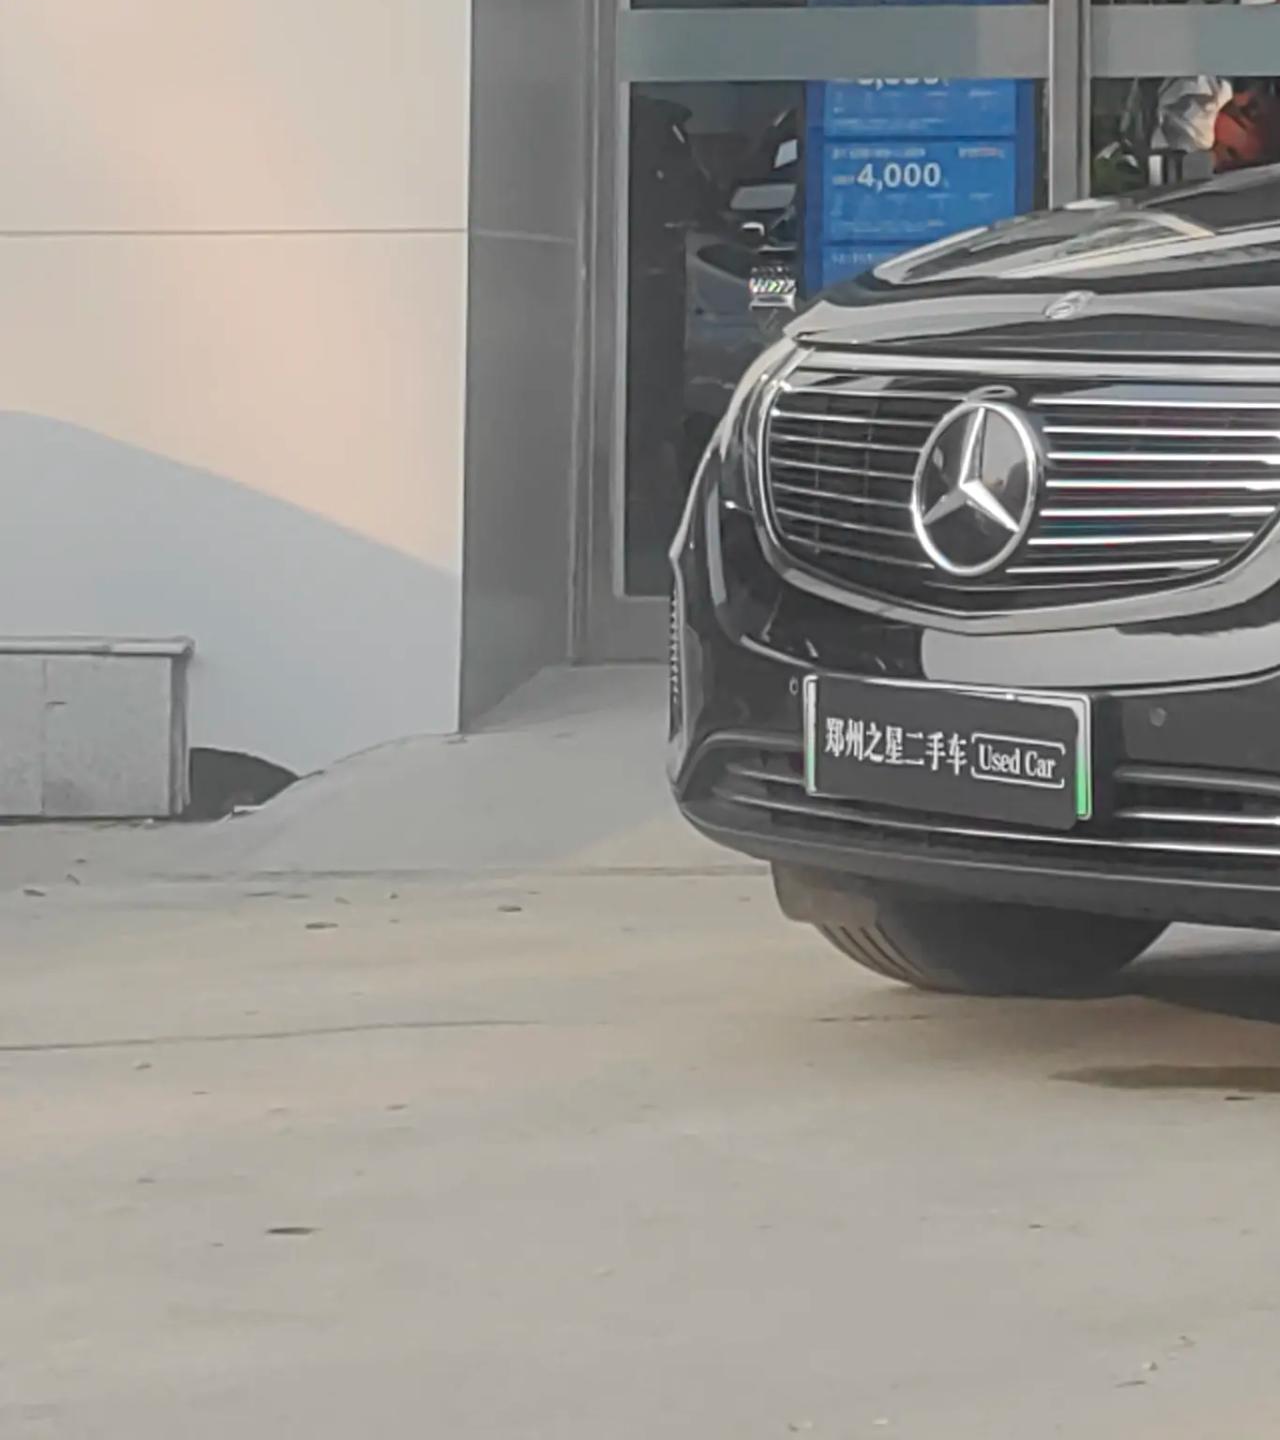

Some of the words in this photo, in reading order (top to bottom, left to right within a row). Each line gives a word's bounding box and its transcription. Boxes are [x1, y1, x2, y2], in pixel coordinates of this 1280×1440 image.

[856, 162, 942, 192] 4,000
[823, 716, 968, 776] 郑州之星二手车
[978, 743, 1021, 775] Used
[1025, 748, 1057, 780] Car
